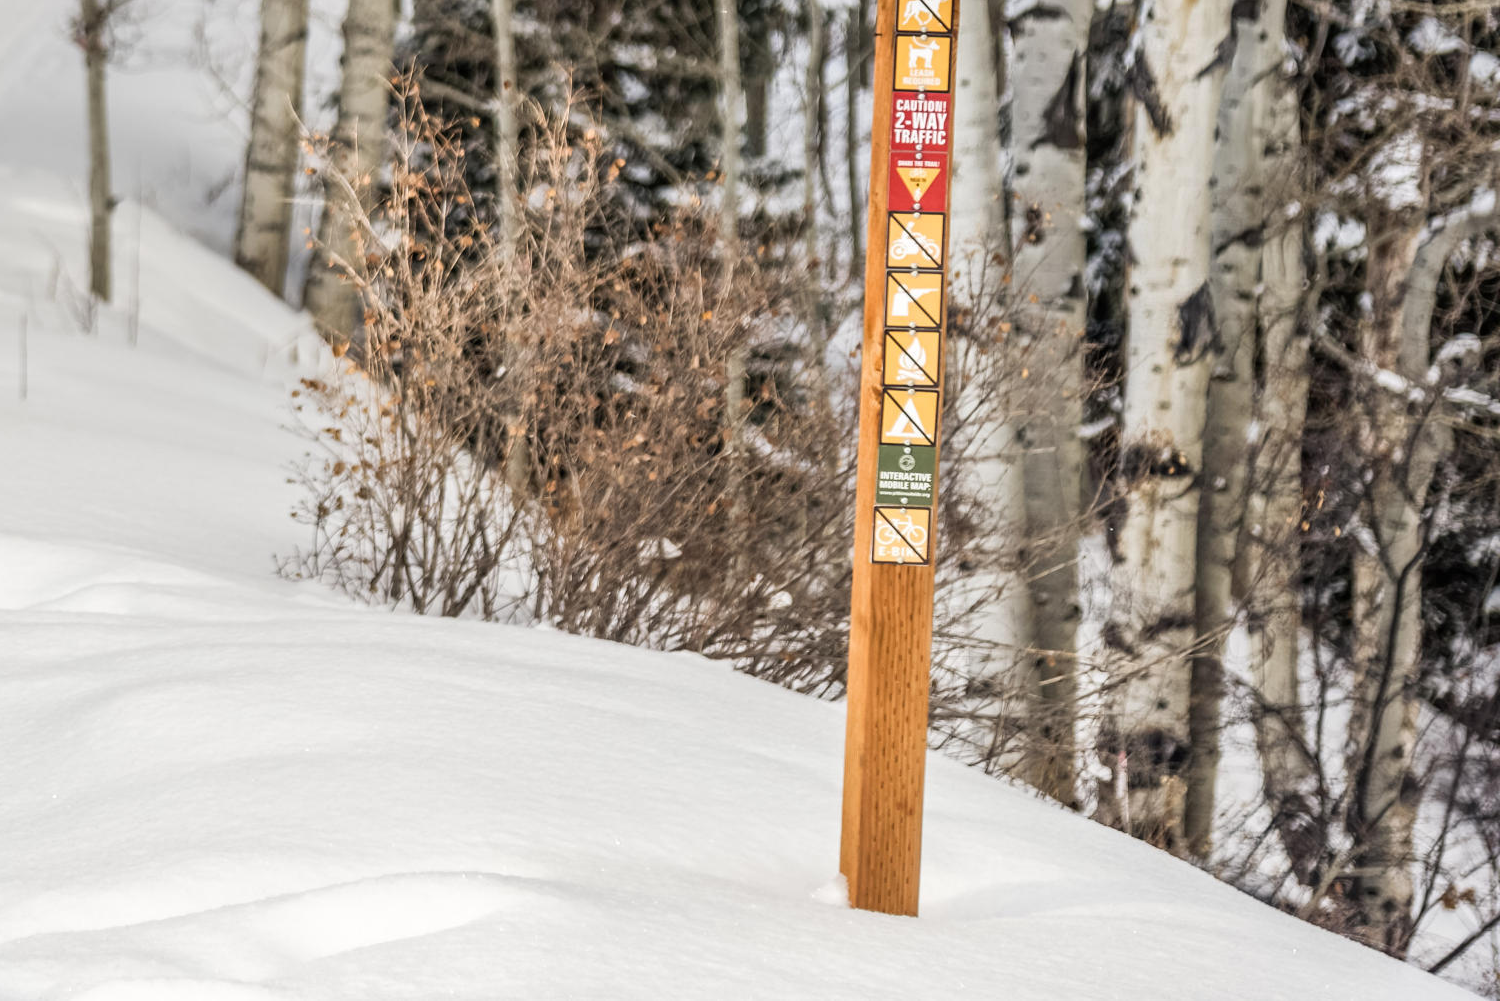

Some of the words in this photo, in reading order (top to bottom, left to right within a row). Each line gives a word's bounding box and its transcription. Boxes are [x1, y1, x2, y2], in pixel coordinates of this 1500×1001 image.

[895, 99, 947, 113] CAUTION!
[894, 111, 948, 131] 2-WAY
[894, 128, 947, 146] TRAFFIC
[879, 471, 932, 482] INTERACTIVE
[879, 480, 909, 490] MOBILE
